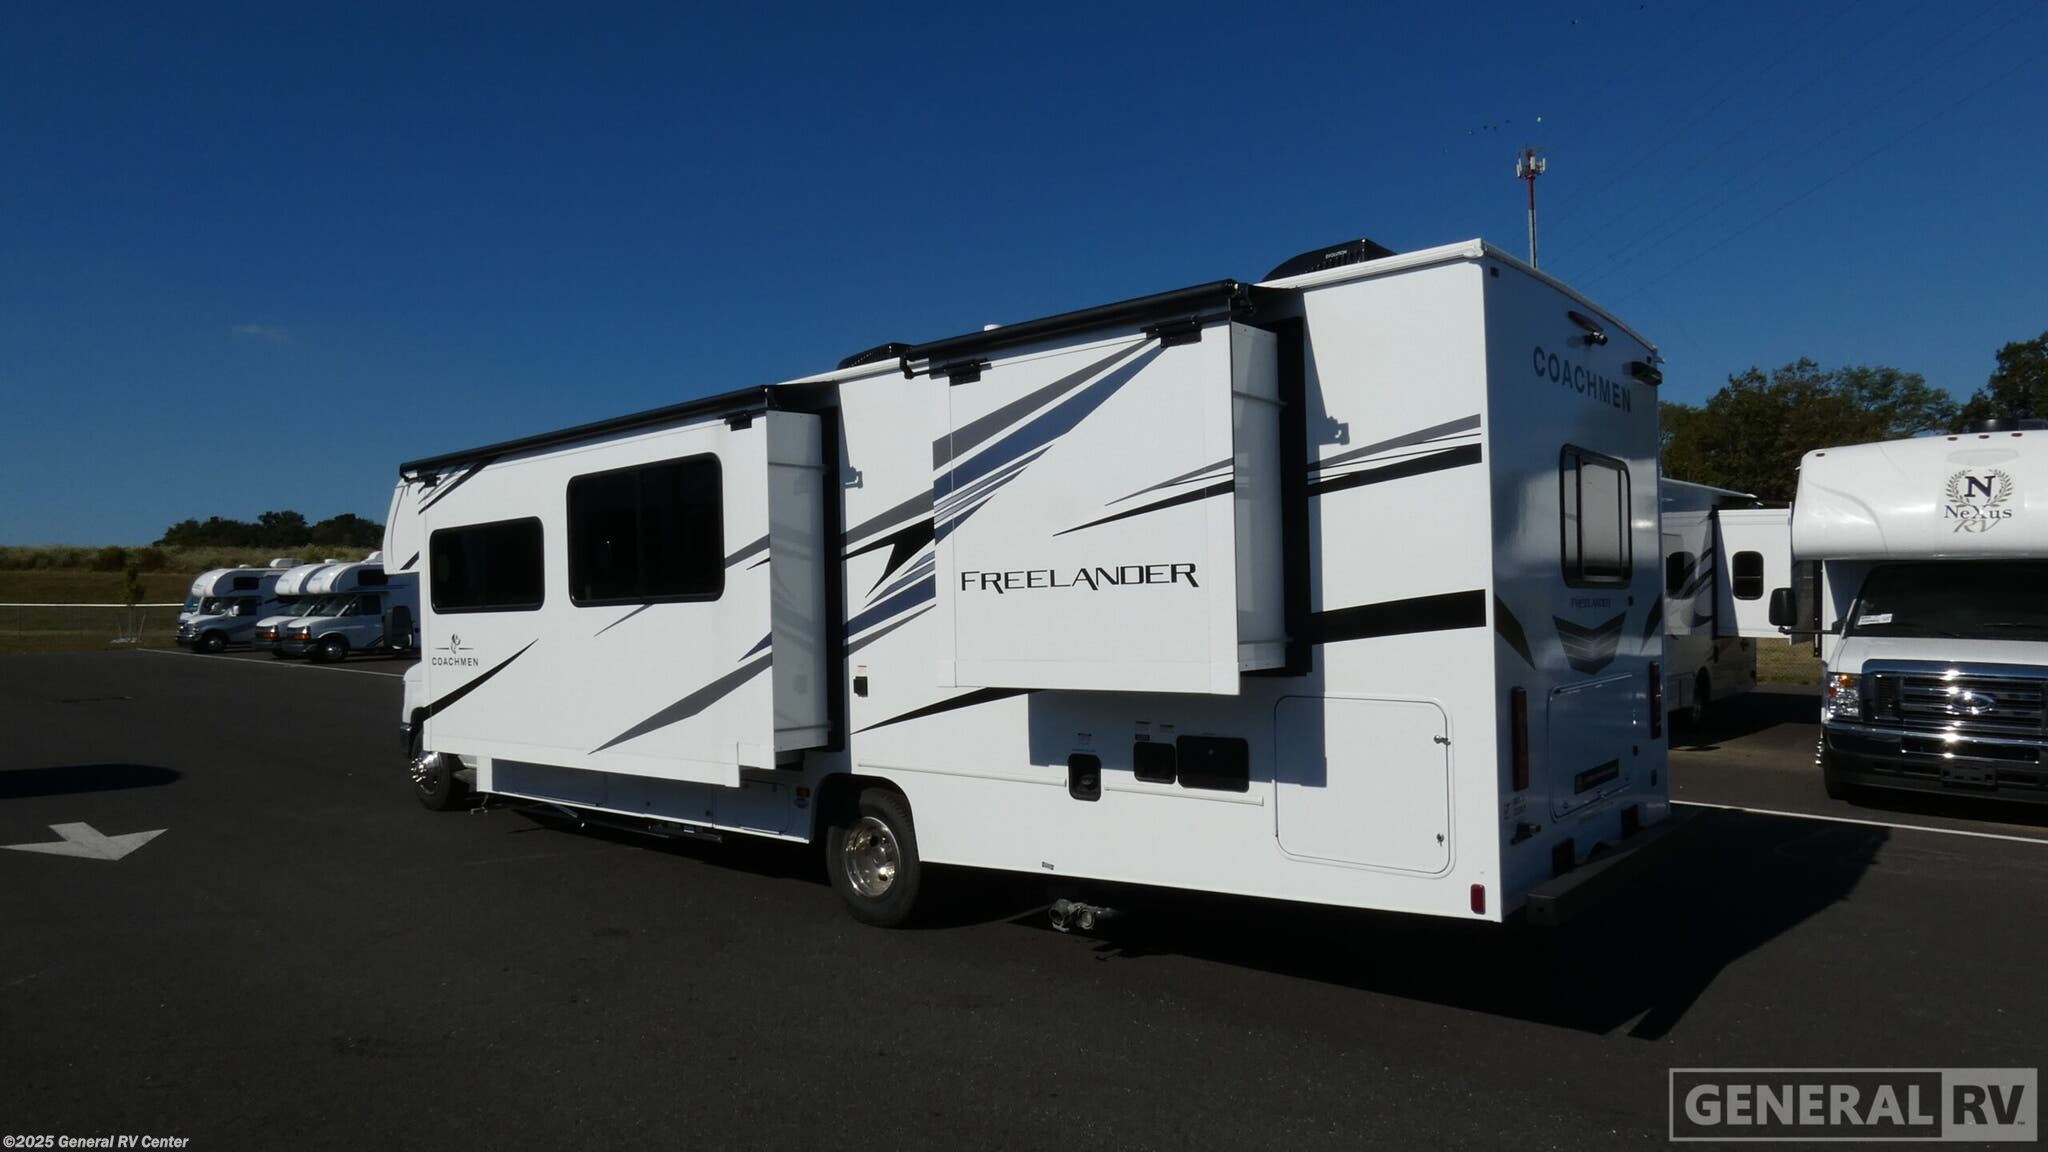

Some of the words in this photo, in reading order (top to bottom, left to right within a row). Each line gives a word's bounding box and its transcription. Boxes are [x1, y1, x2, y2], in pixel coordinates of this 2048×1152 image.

[1533, 346, 1632, 413] COACHMEN
[1964, 475, 1996, 498] N
[1953, 519, 2001, 533] RV
[961, 563, 1200, 595] FREELANDER
[431, 657, 479, 667] COACHMEN
